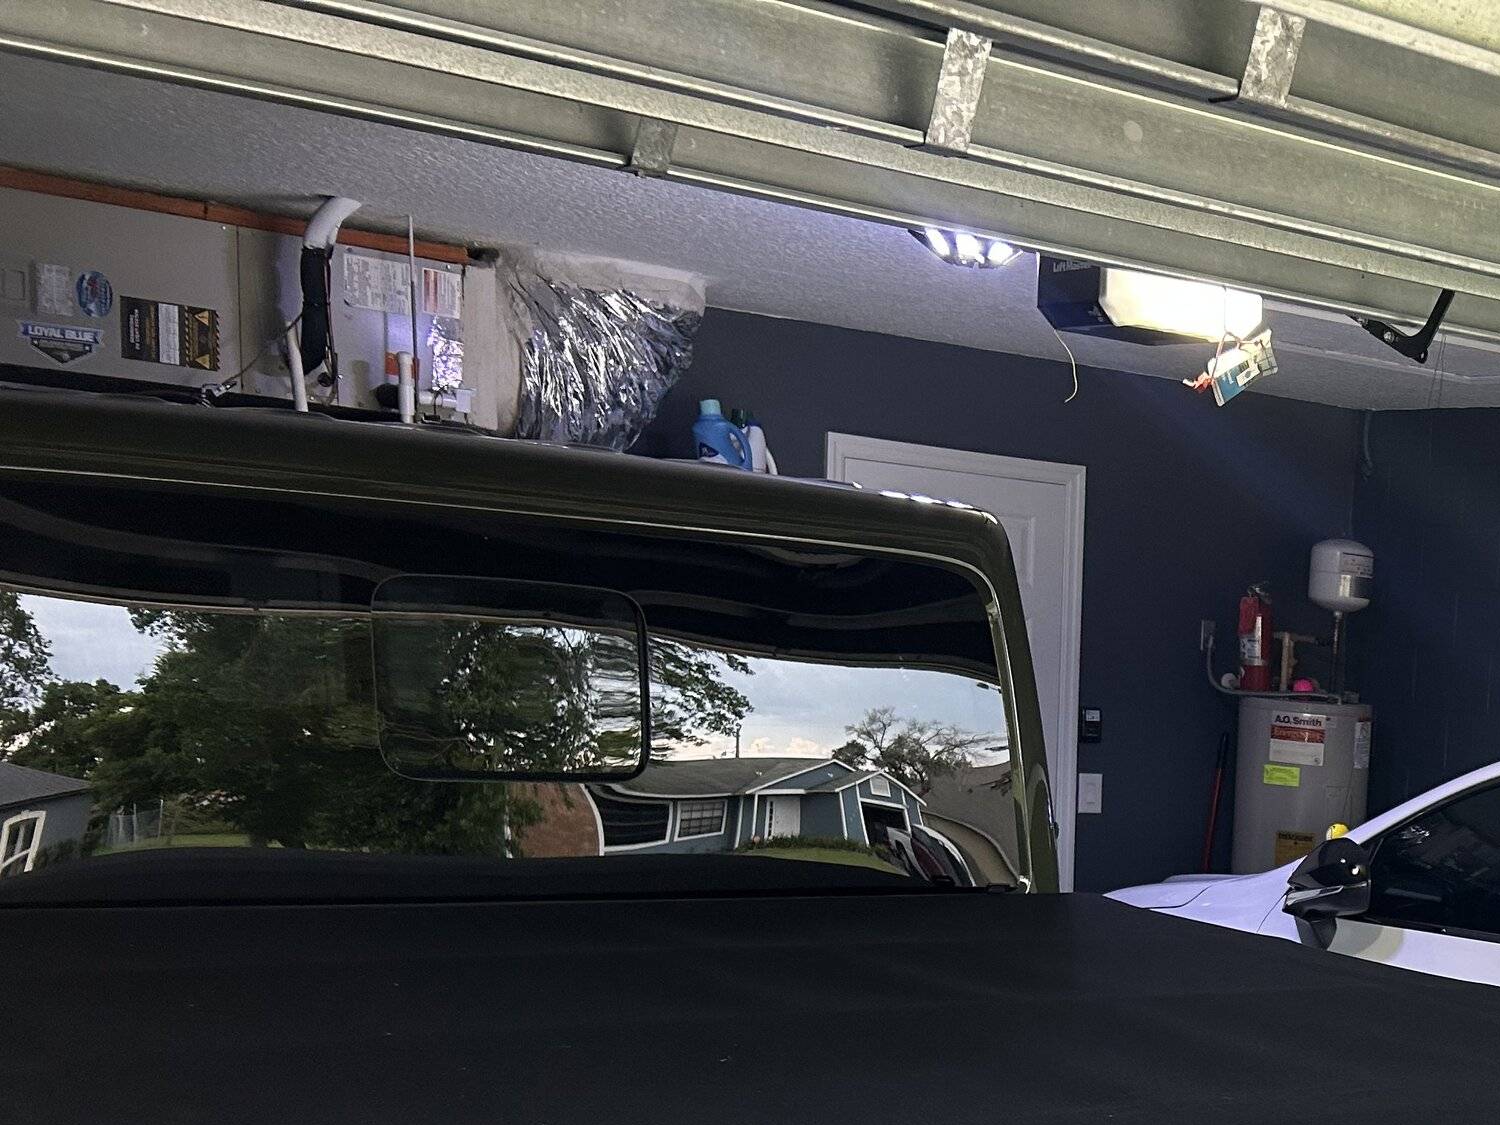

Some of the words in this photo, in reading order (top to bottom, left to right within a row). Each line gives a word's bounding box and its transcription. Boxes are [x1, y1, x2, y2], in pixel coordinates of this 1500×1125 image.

[28, 325, 64, 339] LOYAL
[65, 329, 95, 342] BLUE
[1293, 717, 1322, 727] Smith
